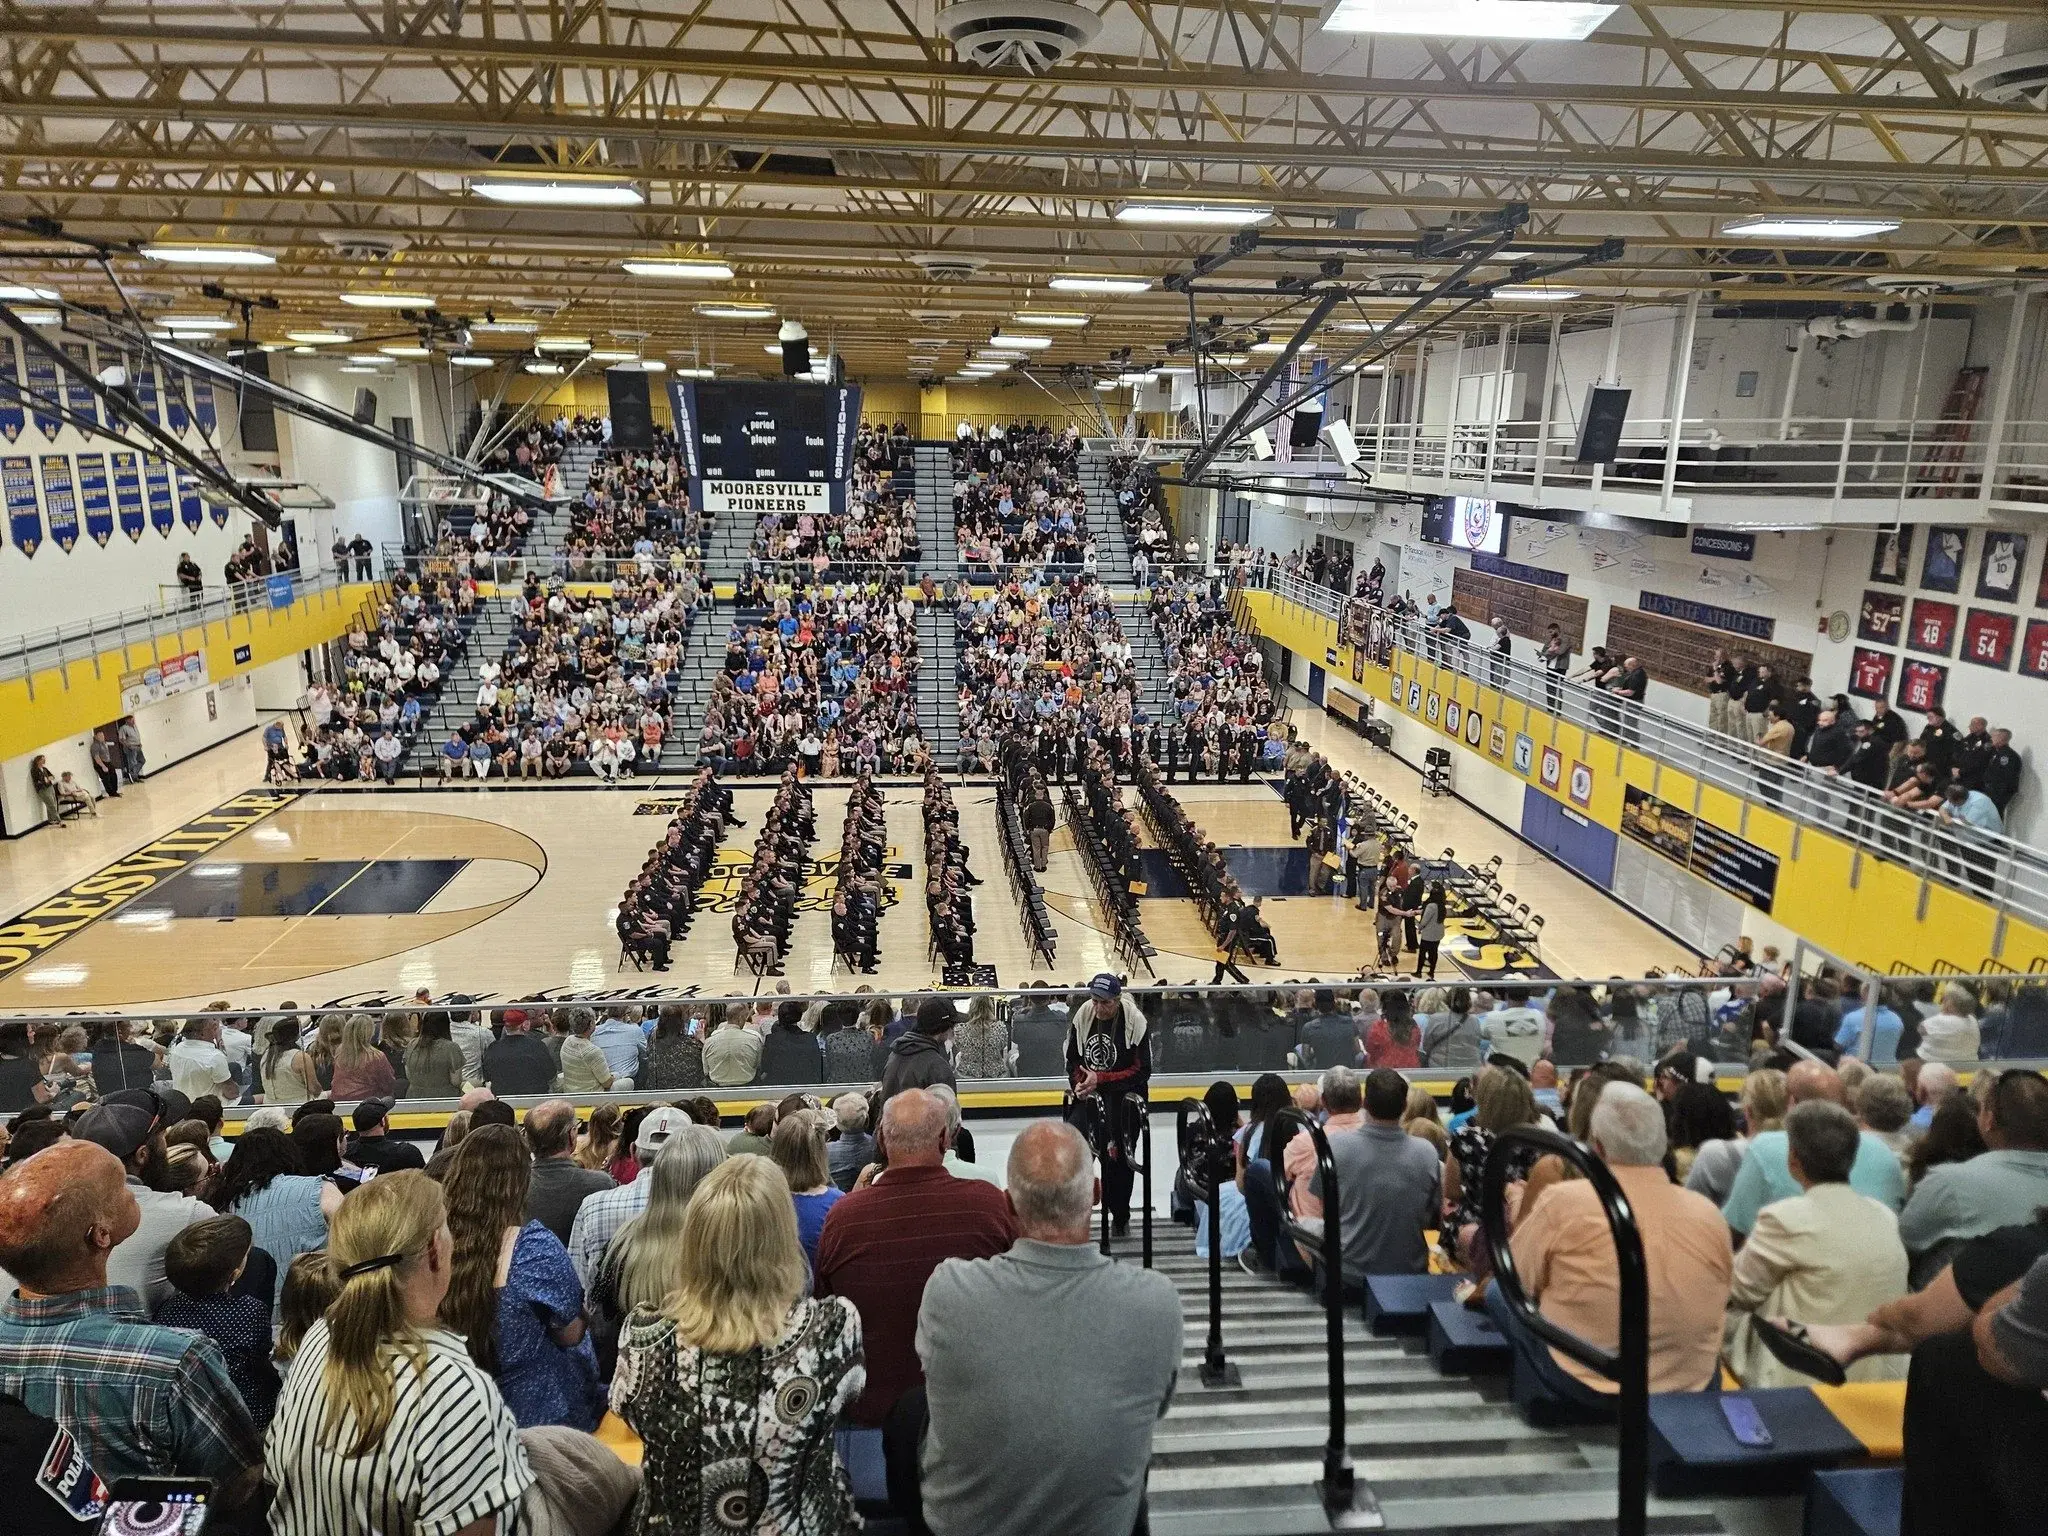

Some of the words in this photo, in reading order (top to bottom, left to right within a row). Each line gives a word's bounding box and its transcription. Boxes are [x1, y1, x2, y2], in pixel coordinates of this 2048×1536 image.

[750, 420, 775, 430] period
[750, 435, 777, 445] player
[834, 389, 848, 479] PIONEERS
[710, 482, 822, 496] MOORESVILLE
[728, 498, 806, 511] PIONEERS
[1694, 536, 1743, 552] CONCESSIONS
[1996, 563, 2008, 573] 10
[1707, 608, 1775, 638] ATHLETES
[1871, 612, 1890, 632] 57
[1923, 625, 1939, 644] 48
[1977, 635, 1997, 658] 54
[1912, 685, 1928, 705] 95
